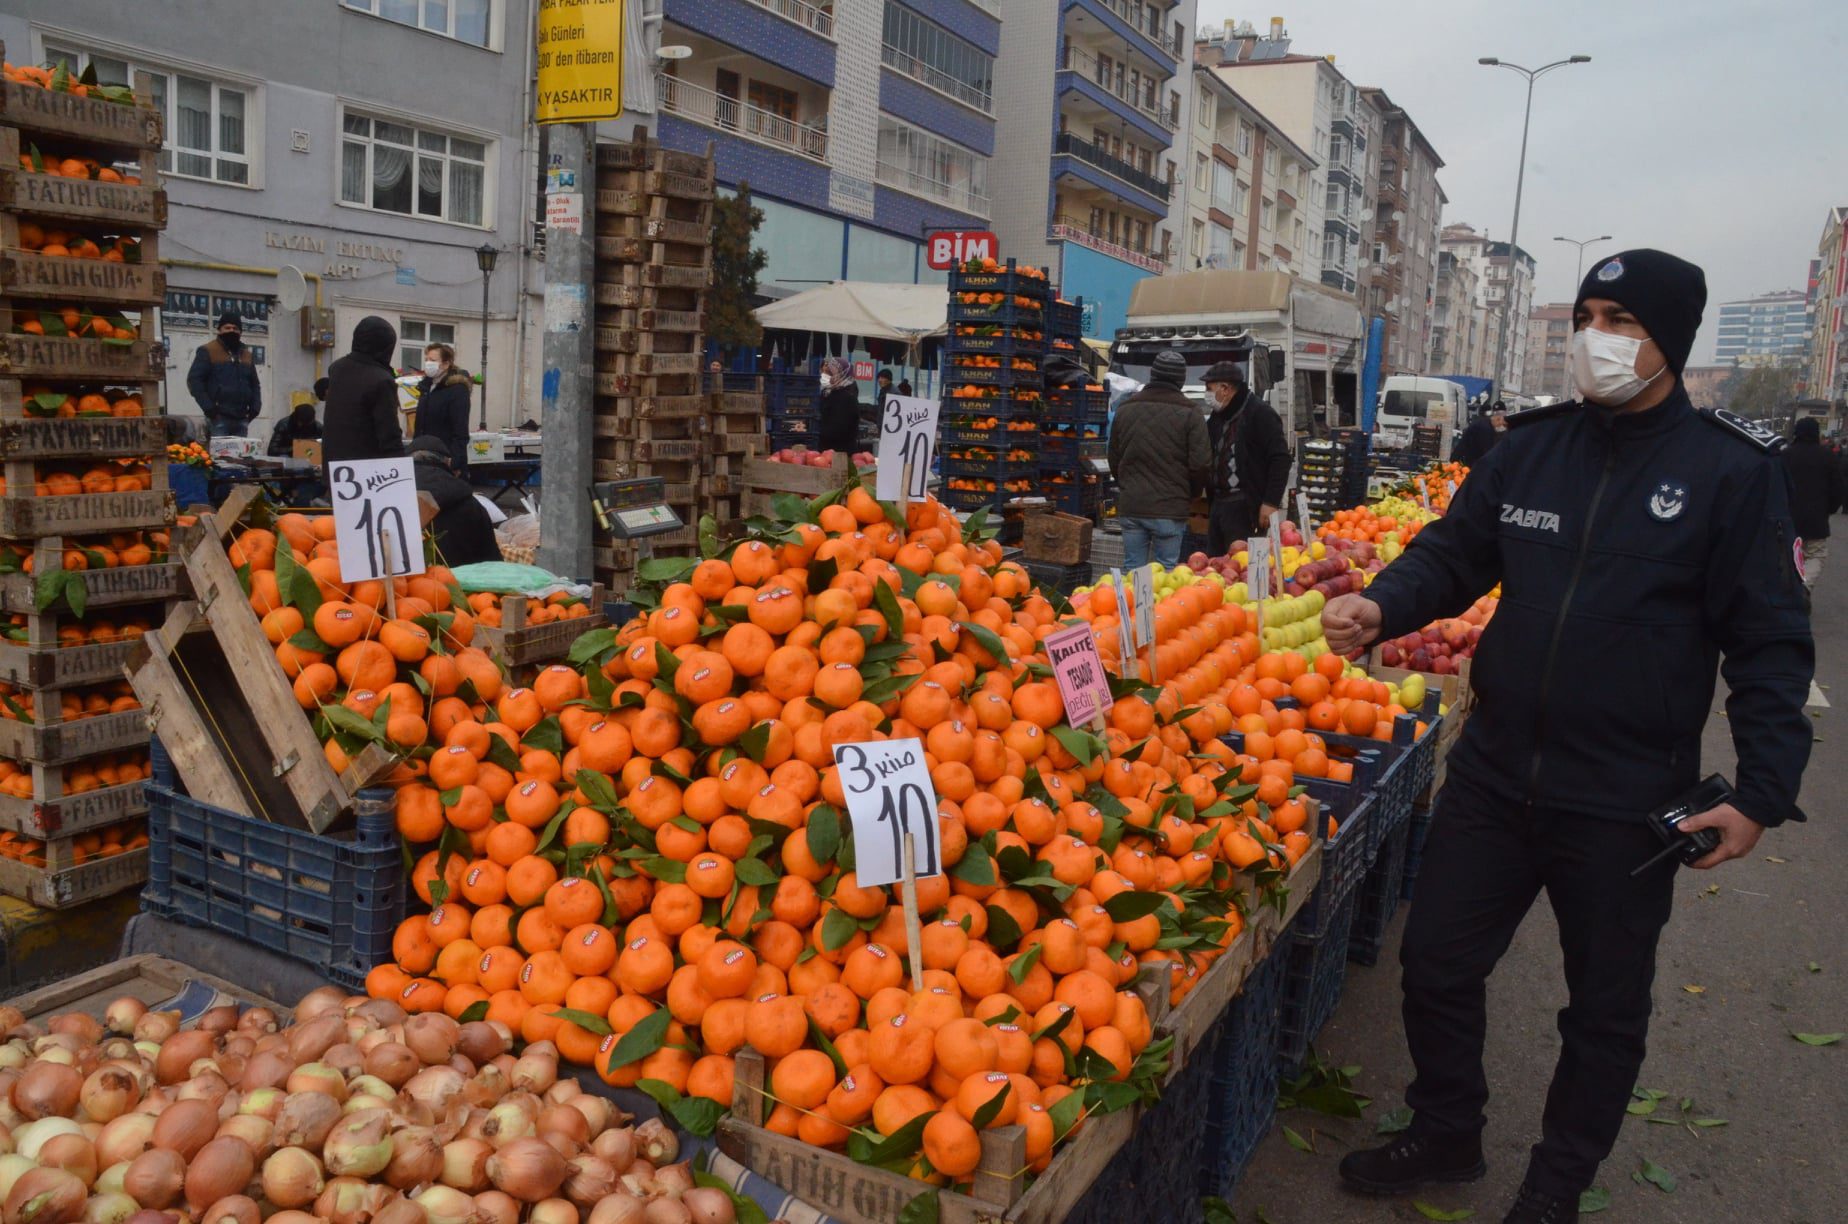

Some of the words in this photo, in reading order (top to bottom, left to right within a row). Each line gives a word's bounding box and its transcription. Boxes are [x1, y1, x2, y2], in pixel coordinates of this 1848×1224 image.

[551, 24, 585, 42] Günleri
[556, 51, 573, 67] den
[576, 48, 614, 65] itibaren
[545, 88, 613, 104] YASAKTIR
[26, 178, 91, 207] FATIH
[933, 232, 989, 263] BİM
[22, 261, 86, 287] FATIH
[88, 264, 137, 289] GIDA
[323, 263, 361, 279] APT
[884, 399, 903, 434] 3
[898, 430, 929, 498] 10
[333, 466, 363, 501] 3
[110, 496, 157, 519] GIDA
[1500, 503, 1561, 533] ZABITA
[354, 498, 412, 578] 10
[127, 566, 171, 593] GIDA
[835, 745, 876, 793] 3
[875, 751, 916, 779] KİLO
[877, 783, 938, 879] 10
